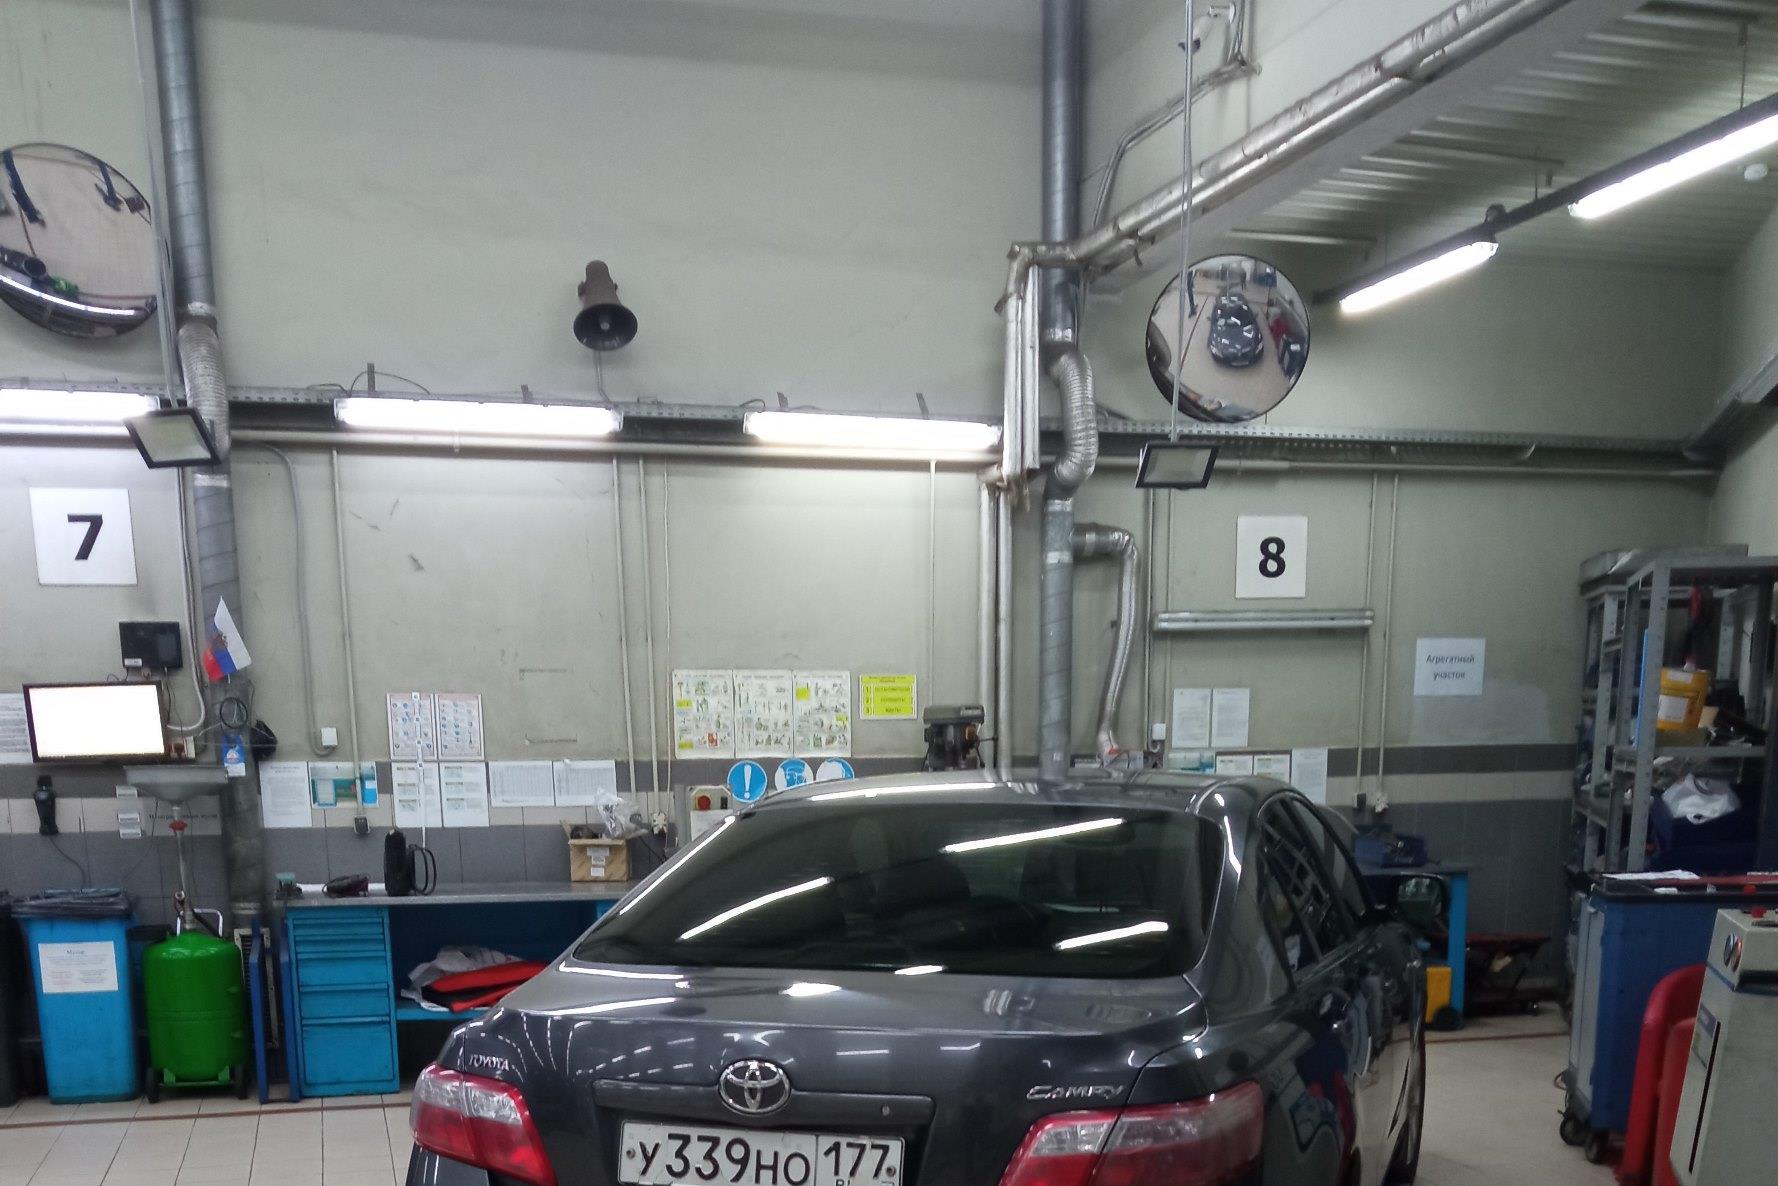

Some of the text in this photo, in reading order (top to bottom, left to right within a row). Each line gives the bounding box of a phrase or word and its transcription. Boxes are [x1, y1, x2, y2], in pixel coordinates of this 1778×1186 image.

[67, 515, 103, 560] 7
[1258, 537, 1286, 578] 8
[1425, 653, 1476, 664] Агрегатный
[1432, 671, 1466, 681] участок
[469, 1054, 510, 1071] TOYOTA
[823, 1140, 890, 1179] 177
